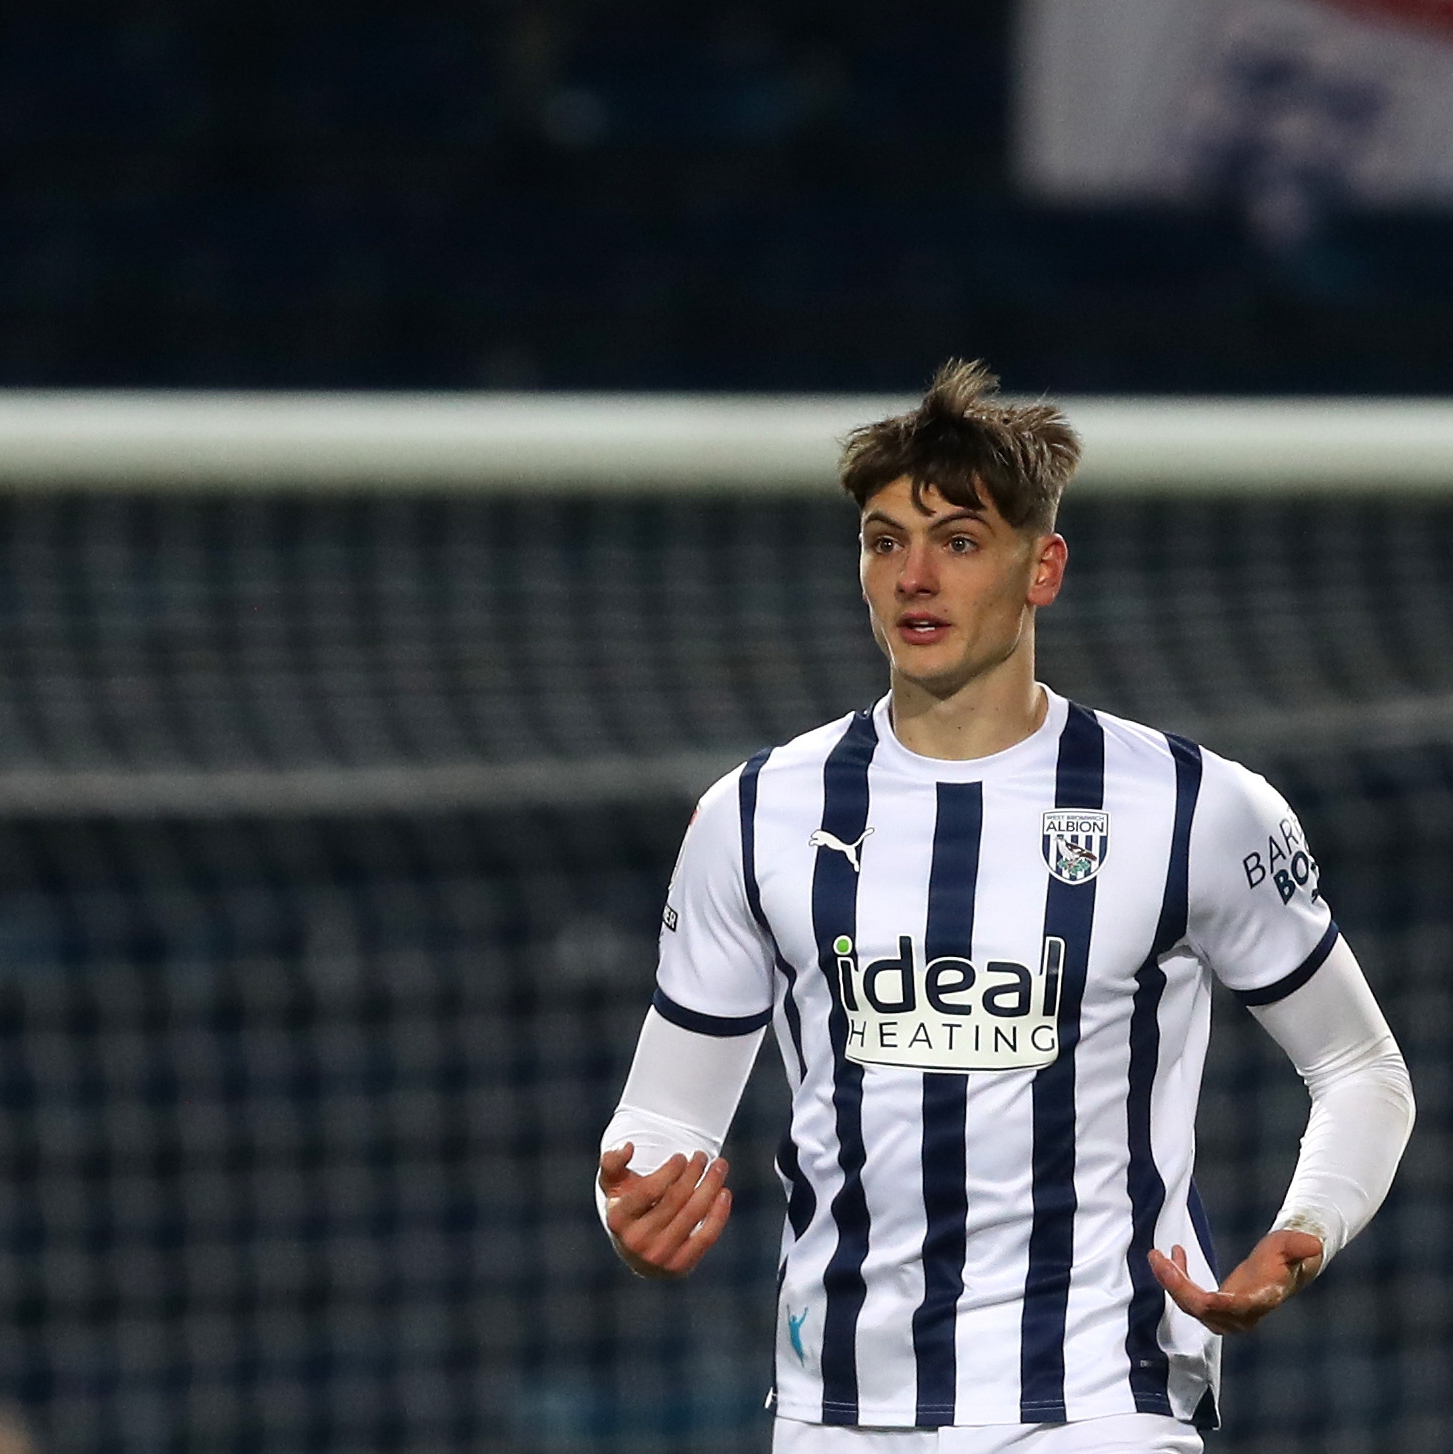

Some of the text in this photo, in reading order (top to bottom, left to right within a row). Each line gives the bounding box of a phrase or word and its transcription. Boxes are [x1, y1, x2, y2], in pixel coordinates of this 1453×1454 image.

[1046, 820, 1104, 833] ALBION
[835, 935, 1063, 1018] ideal
[848, 1019, 1056, 1053] HEATING
